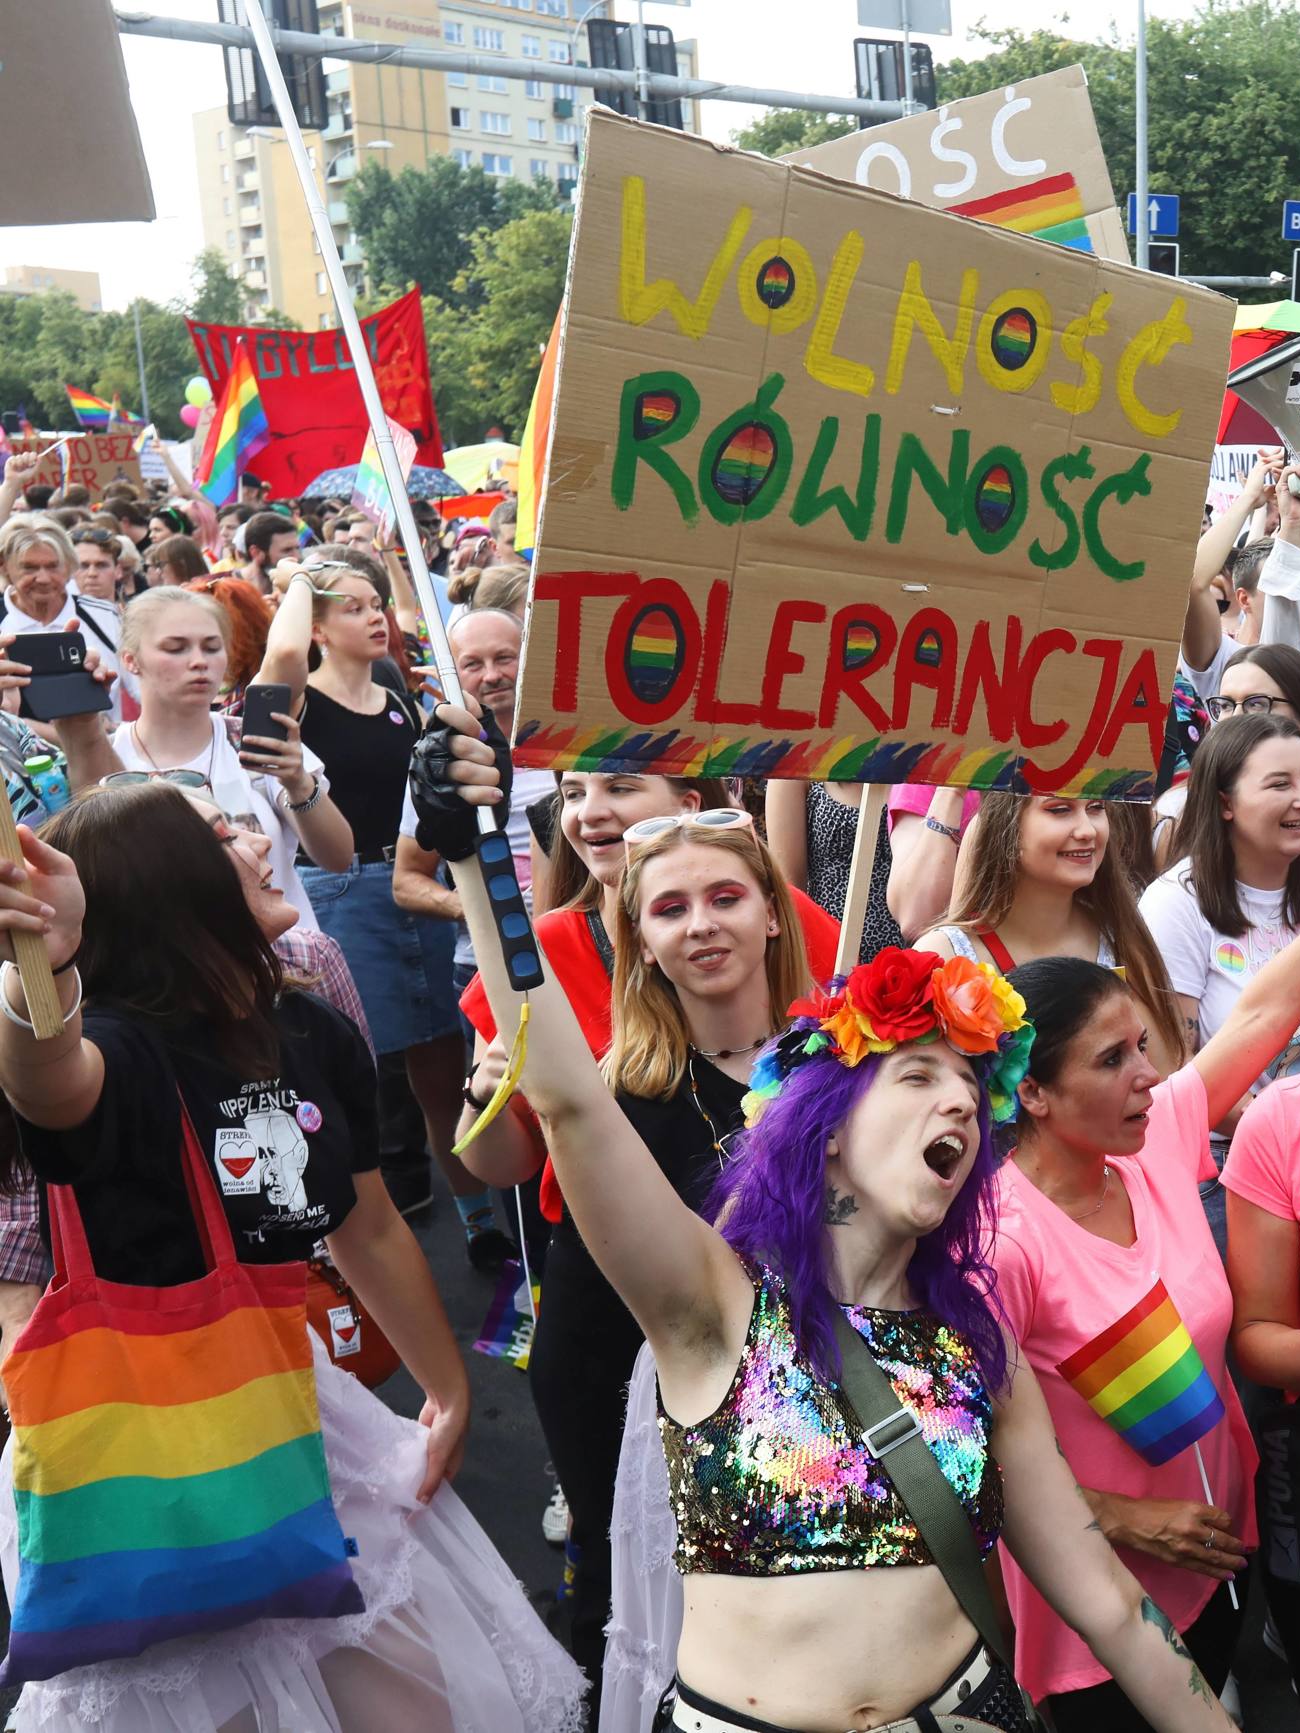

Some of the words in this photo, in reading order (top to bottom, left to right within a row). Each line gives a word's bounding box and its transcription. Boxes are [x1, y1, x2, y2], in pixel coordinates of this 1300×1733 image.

[804, 86, 1047, 199] OŚĆ
[617, 175, 1193, 438] WOLNOŚĆ
[95, 434, 137, 464] BEZ
[611, 373, 1152, 582] RÓWNOŚĆ
[535, 572, 1171, 791] TOLERANCJA
[307, 1204, 326, 1218] ME
[1262, 1429, 1295, 1523] PUMA
